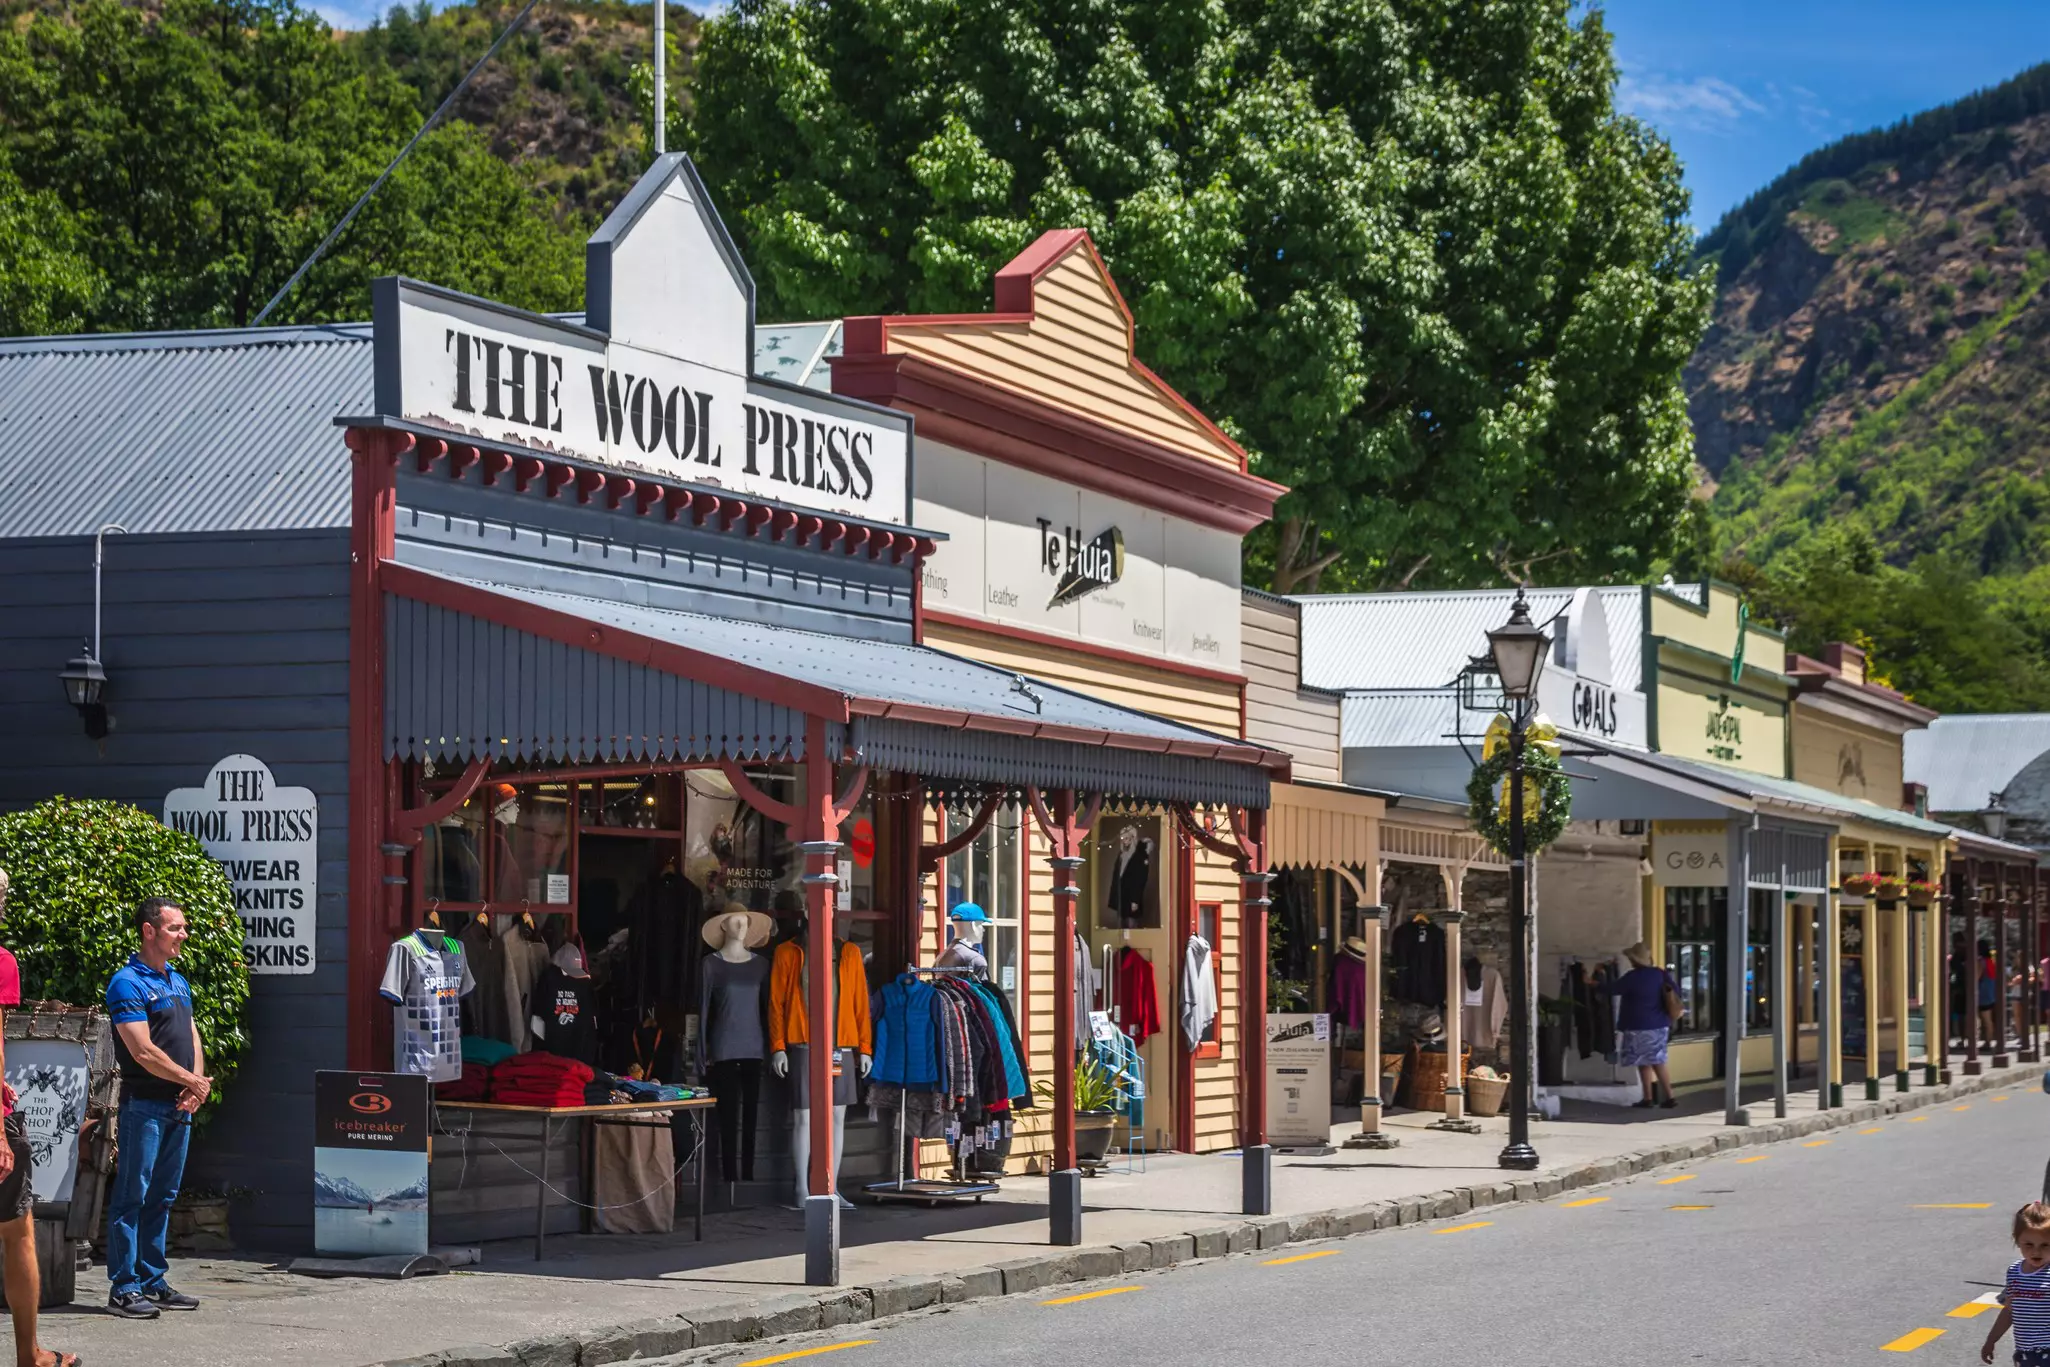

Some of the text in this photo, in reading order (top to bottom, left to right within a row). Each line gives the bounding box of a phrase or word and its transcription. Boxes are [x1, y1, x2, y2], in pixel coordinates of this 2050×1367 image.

[446, 329, 873, 501] THE WOOL PRESS
[1036, 517, 1112, 583] Te Huia
[988, 584, 1018, 607] Leather
[1133, 619, 1162, 640] Knitwear
[1573, 682, 1616, 736] GOALS
[216, 771, 264, 802] THE
[171, 809, 312, 842] WOOL PRESS
[726, 868, 773, 878] MADE FOR
[726, 879, 777, 890] ADVENTURE
[24, 1106, 54, 1116] CHOP
[335, 1118, 406, 1133] icebreaker
